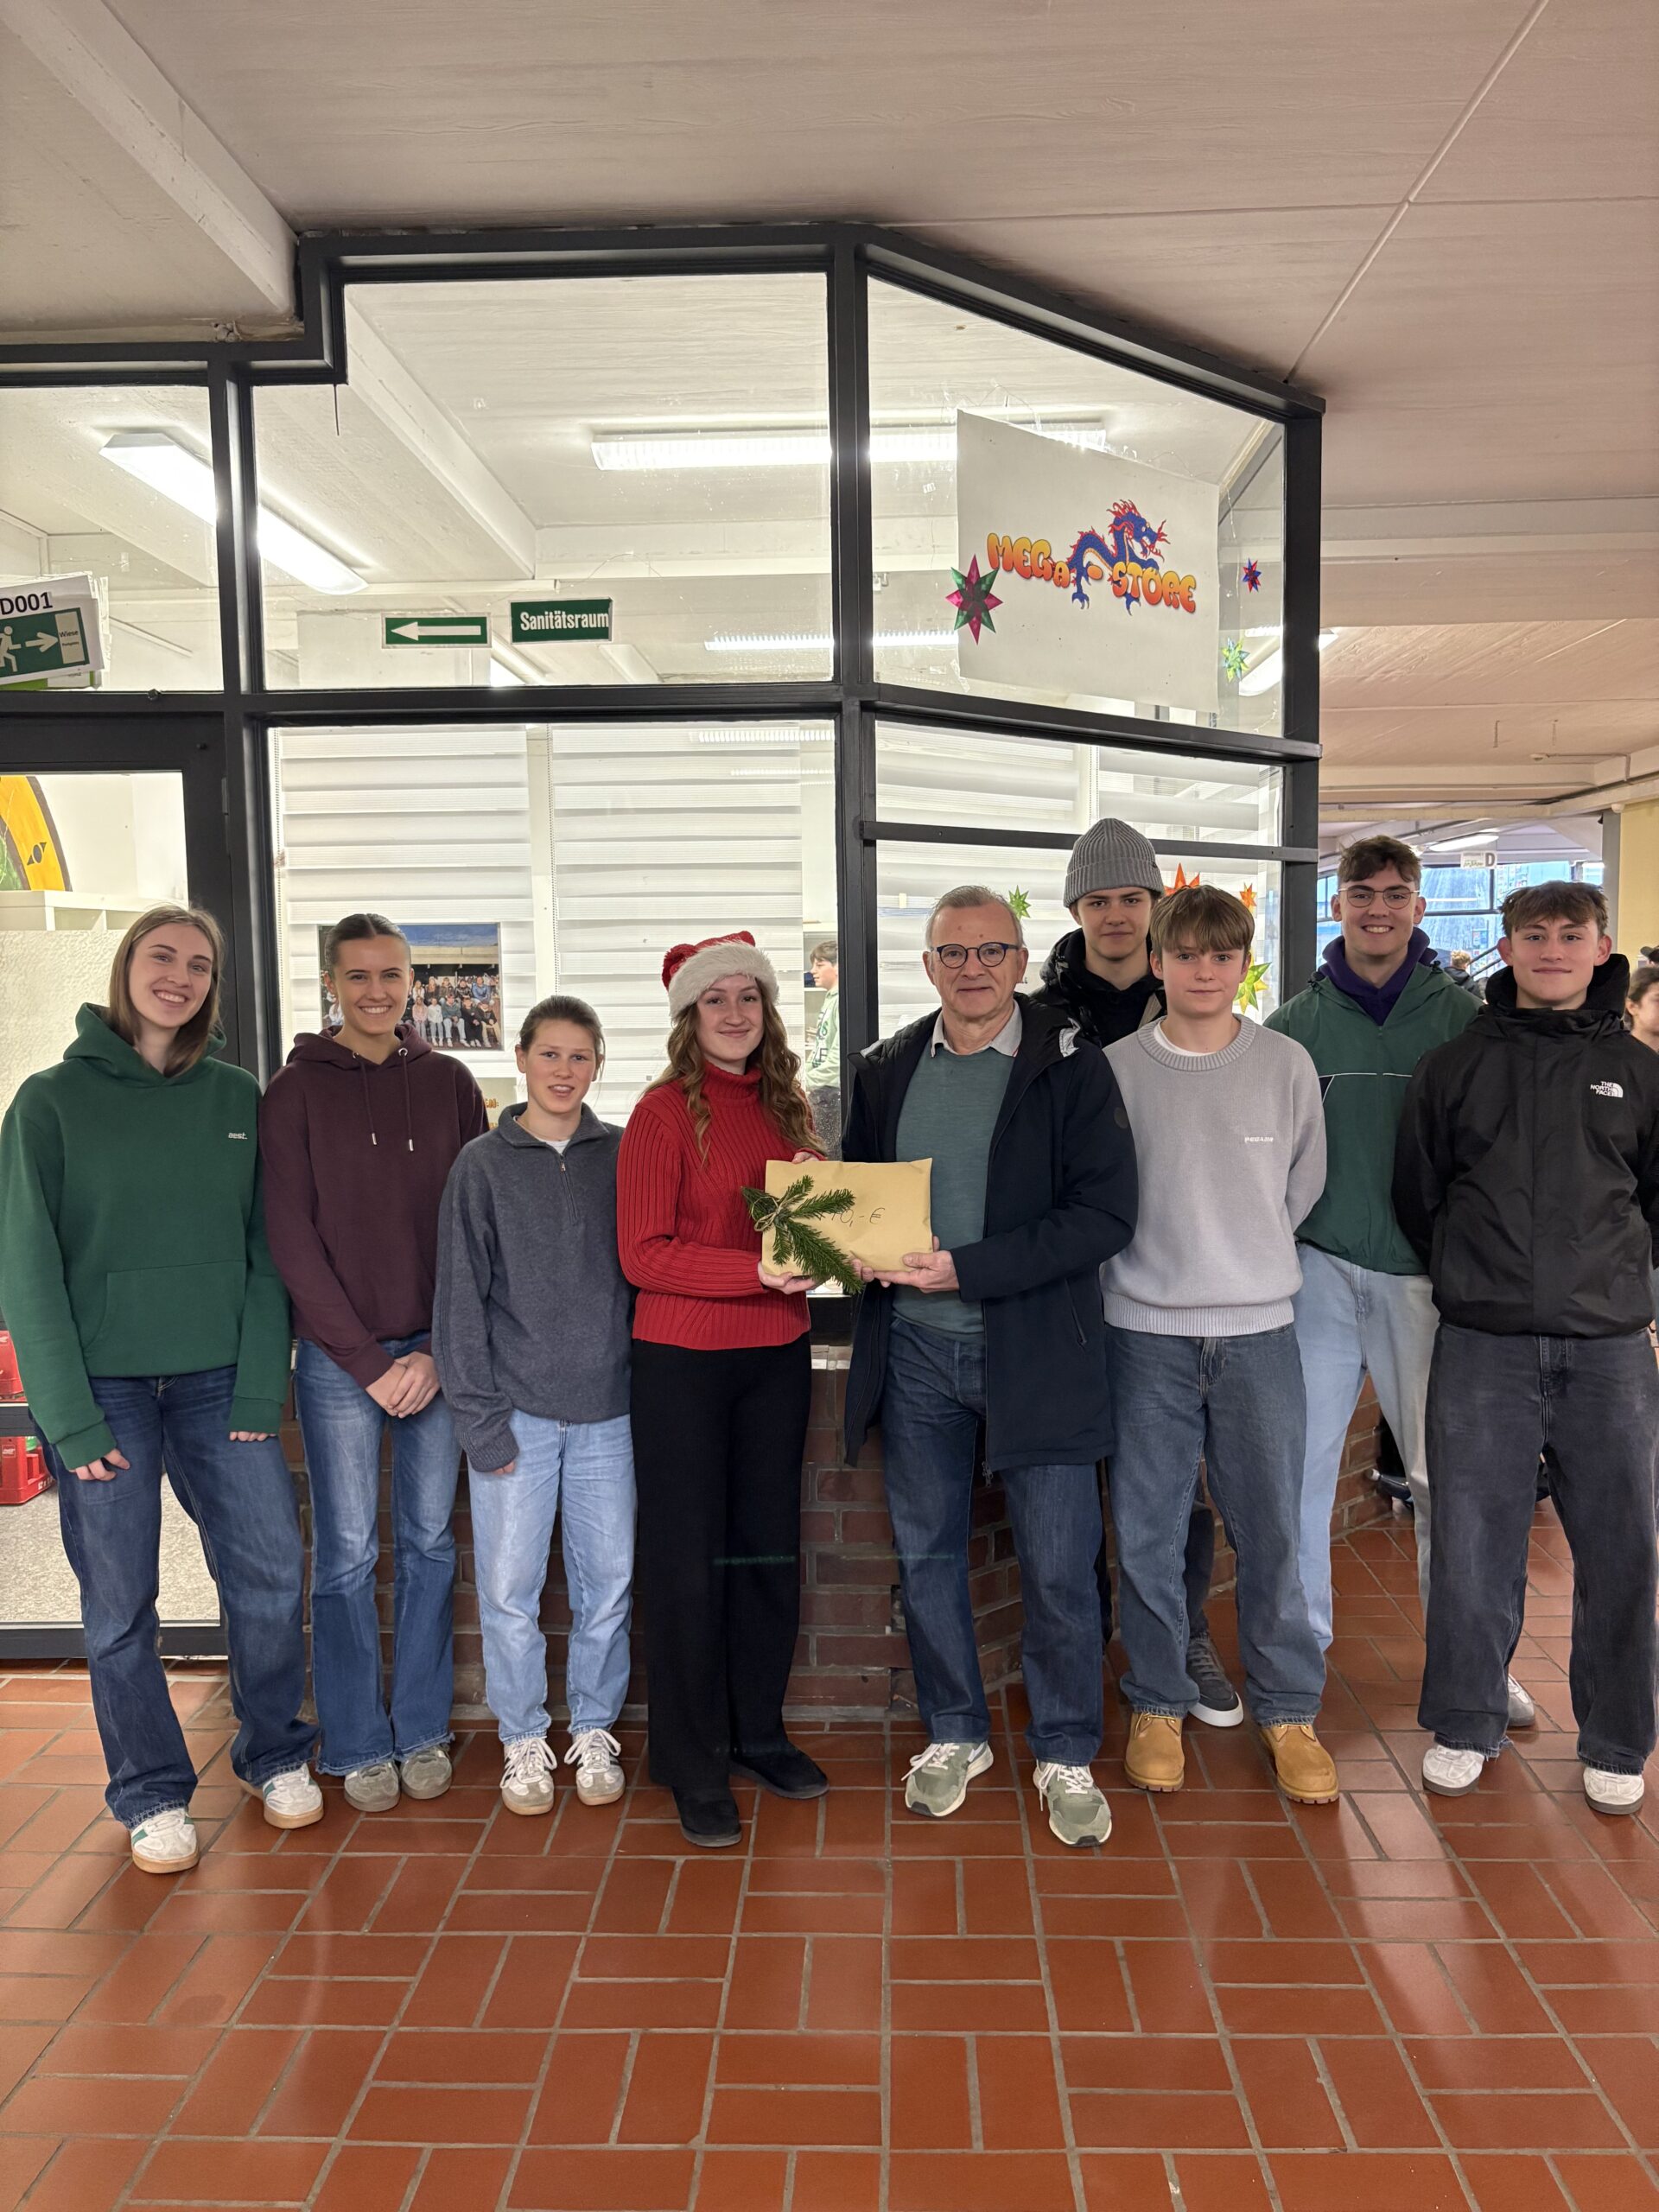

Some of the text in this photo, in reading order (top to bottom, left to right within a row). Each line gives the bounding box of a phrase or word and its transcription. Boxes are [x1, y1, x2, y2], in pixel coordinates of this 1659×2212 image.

[987, 532, 1071, 588] MEGA
[1112, 562, 1198, 614] STORE
[0, 591, 54, 616] D001
[519, 610, 609, 632] Sanitätsraum
[1485, 852, 1496, 868] D
[1590, 1084, 1612, 1092] NORTH
